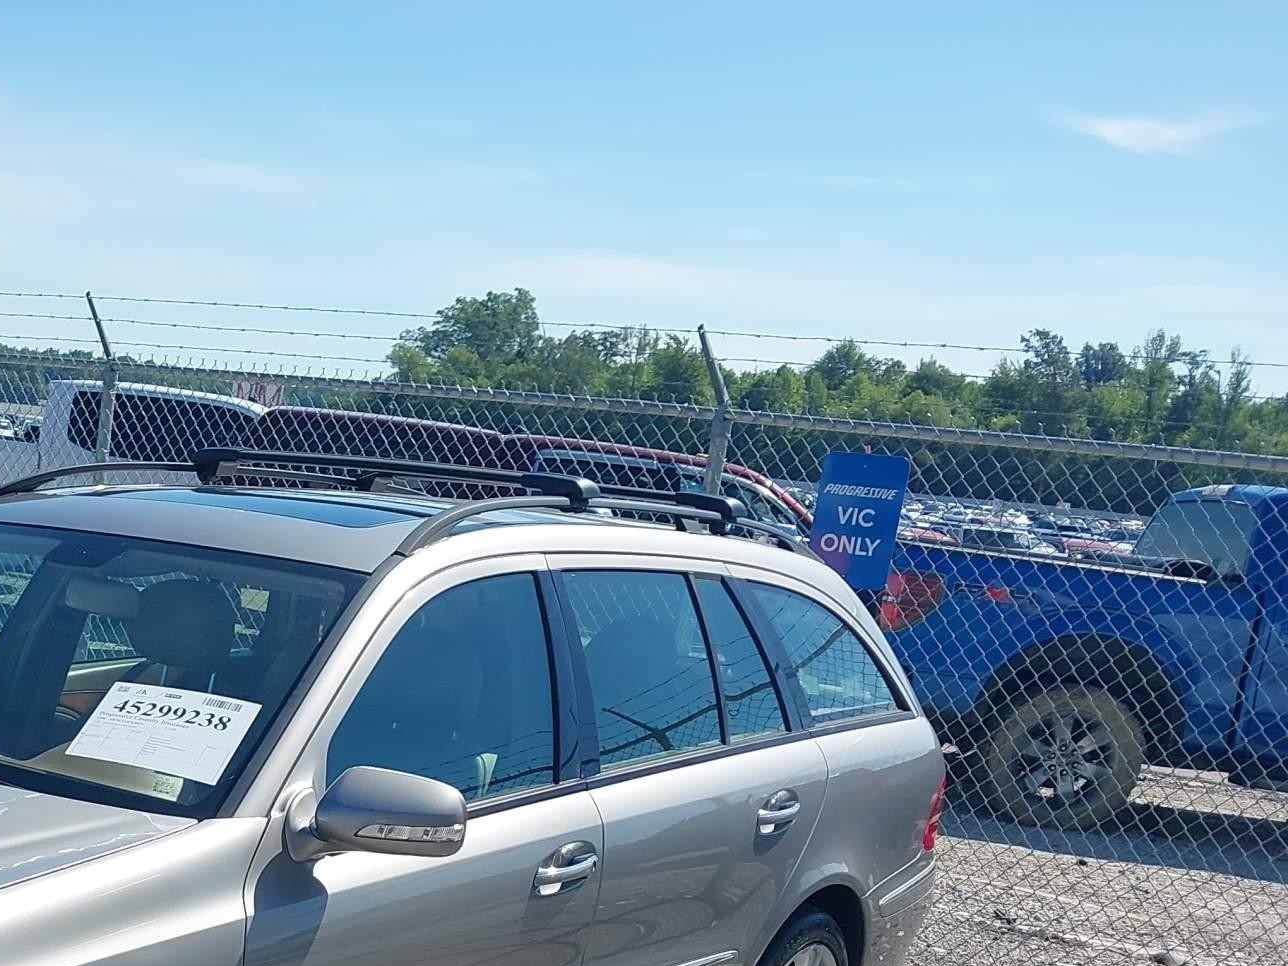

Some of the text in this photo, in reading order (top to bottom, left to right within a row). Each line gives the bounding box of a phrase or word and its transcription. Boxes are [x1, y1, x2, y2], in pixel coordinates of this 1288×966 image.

[823, 483, 899, 500] PROGRESSIVE
[837, 506, 876, 528] VIC
[820, 533, 881, 557] ONLY
[113, 699, 232, 732] 45299238
